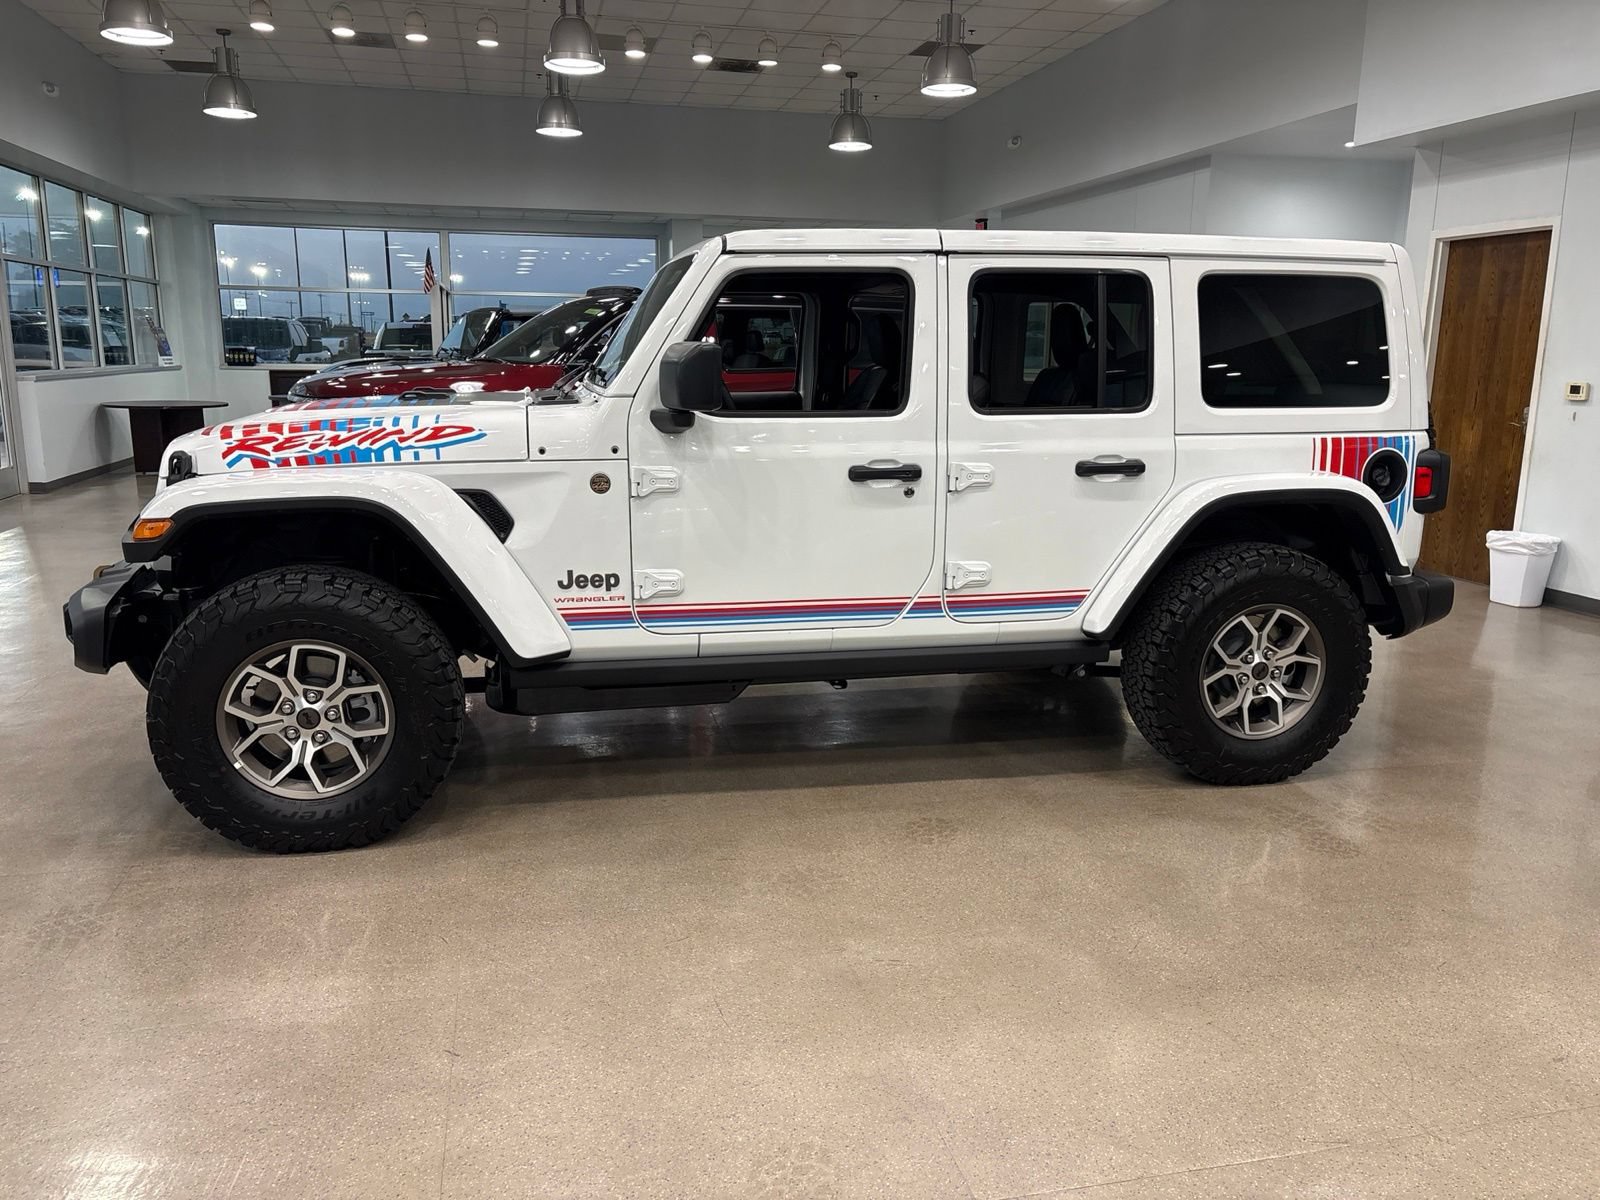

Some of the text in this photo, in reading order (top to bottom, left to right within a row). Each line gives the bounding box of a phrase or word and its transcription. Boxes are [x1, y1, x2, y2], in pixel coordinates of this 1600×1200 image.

[221, 424, 477, 460] REWIND
[557, 569, 620, 592] Jeep
[553, 595, 625, 603] WRANGLER
